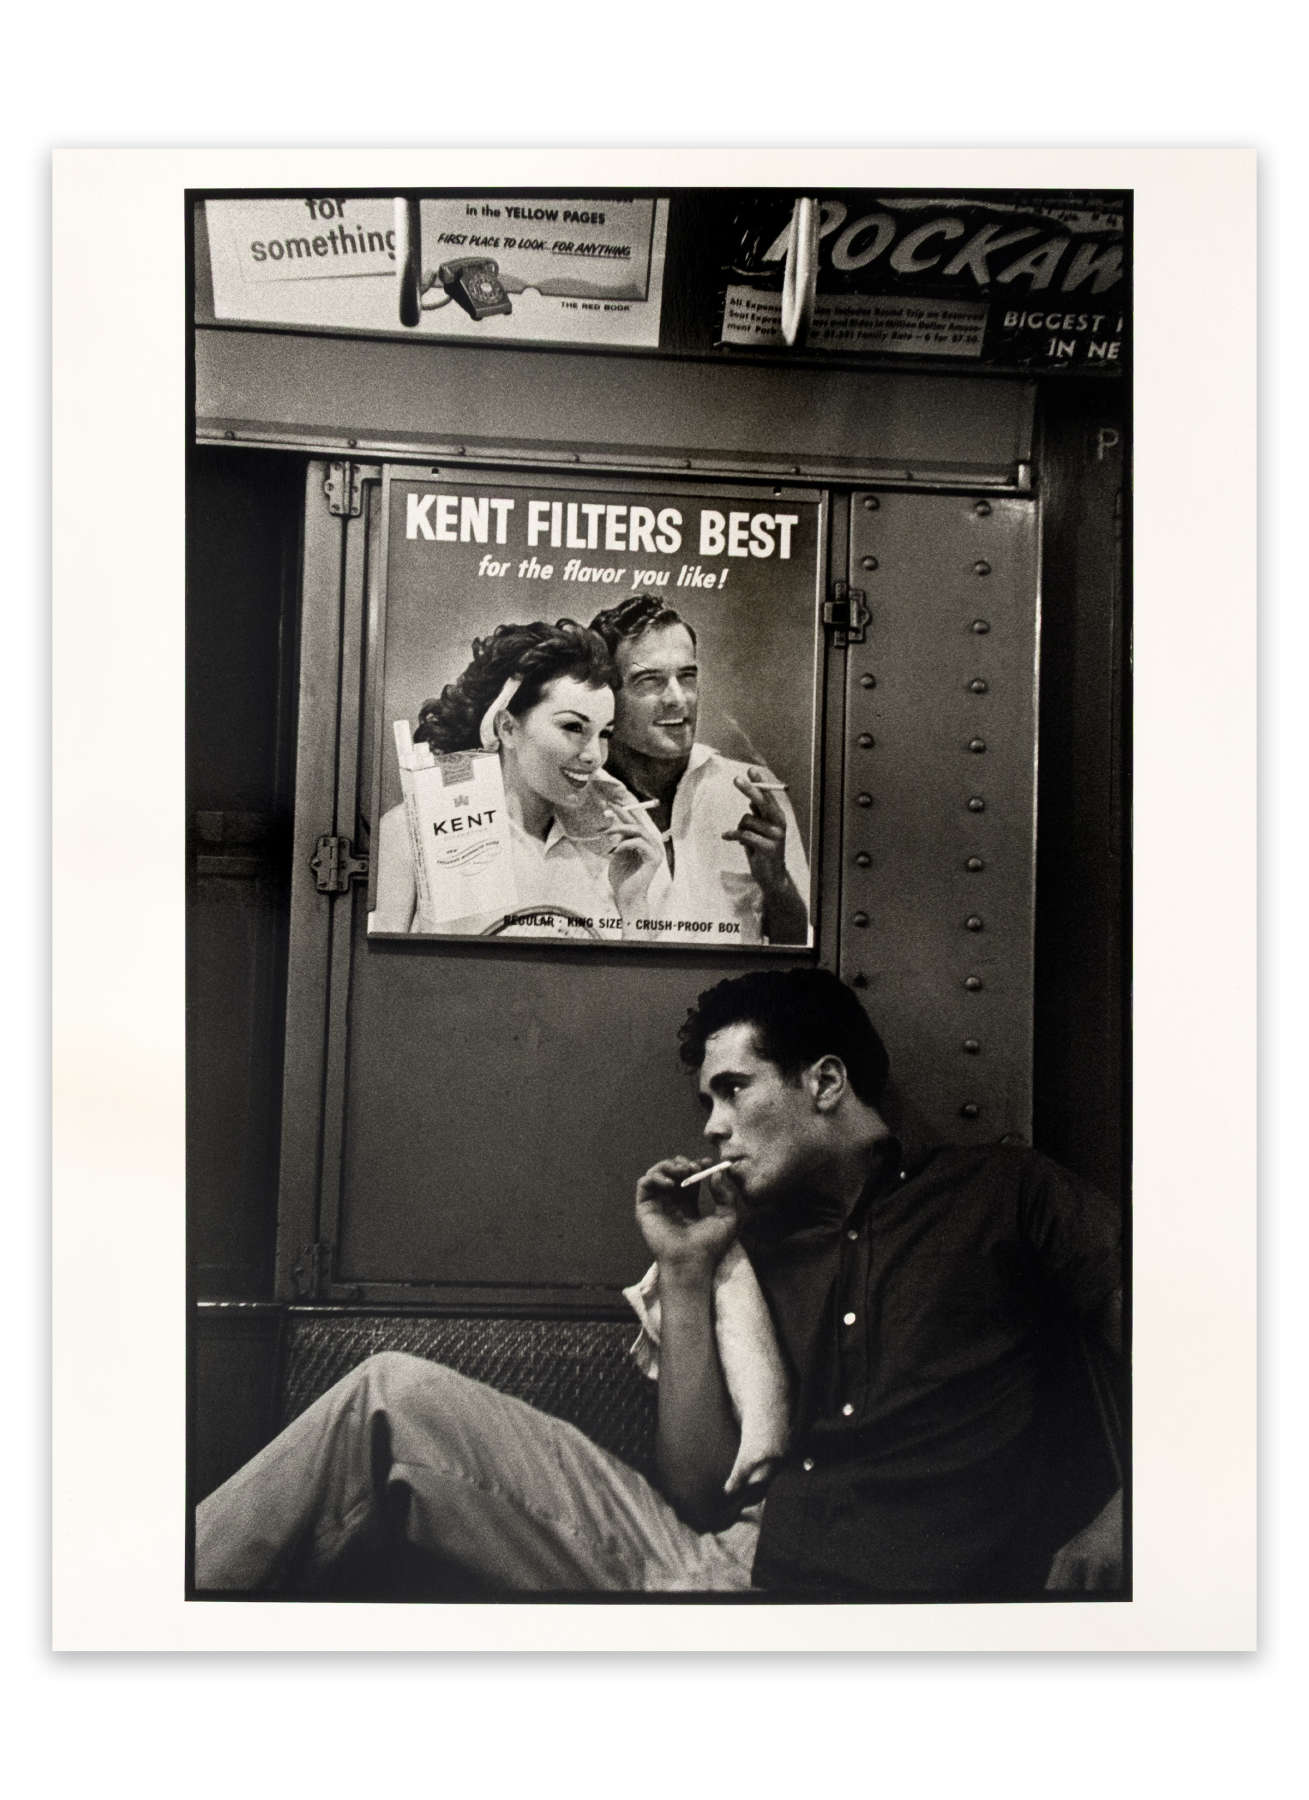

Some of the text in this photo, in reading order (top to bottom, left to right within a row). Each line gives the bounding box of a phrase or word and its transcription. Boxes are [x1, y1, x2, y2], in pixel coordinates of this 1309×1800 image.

[305, 198, 346, 220] for
[466, 204, 606, 225] in the YELLOW PAGES
[438, 233, 468, 245] FIRST
[469, 235, 500, 248] PLACE
[503, 237, 517, 249] TO
[552, 240, 574, 253] FOR
[575, 242, 632, 257] ANYTHING
[582, 303, 600, 311] RED
[1004, 311, 1105, 333] BIGGEST
[1048, 338, 1076, 357] IN
[406, 493, 799, 560] KENT FILTERS BEST
[478, 555, 729, 590] for the flavor you like!
[433, 810, 497, 837] KENT
[504, 914, 741, 934] REGULAR KING SIZE CRUSH-PROOF BOX
